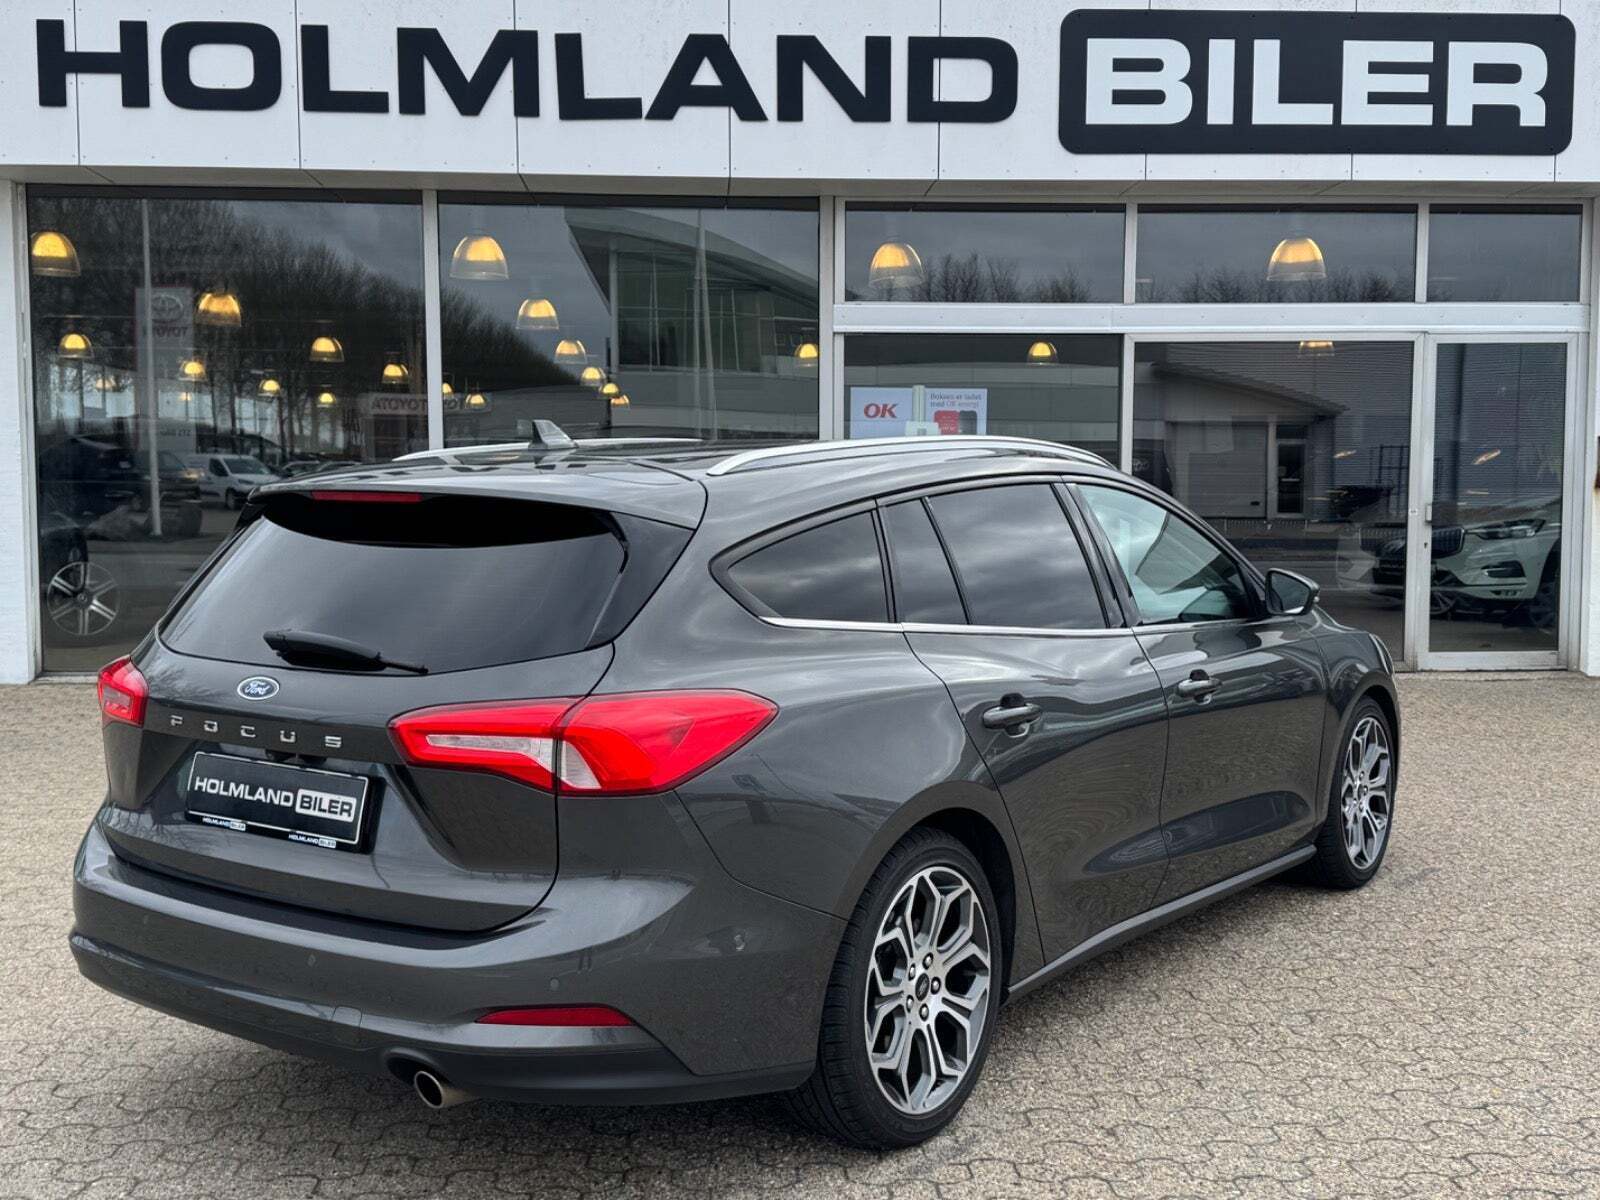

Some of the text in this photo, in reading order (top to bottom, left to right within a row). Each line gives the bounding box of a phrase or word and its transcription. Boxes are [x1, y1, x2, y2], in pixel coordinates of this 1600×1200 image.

[36, 19, 1549, 128] HOLMLAND BILER
[863, 402, 899, 419] OK
[244, 680, 271, 696] Ford
[170, 714, 342, 748] FOCUS
[194, 776, 354, 818] HOLMLAND BILER
